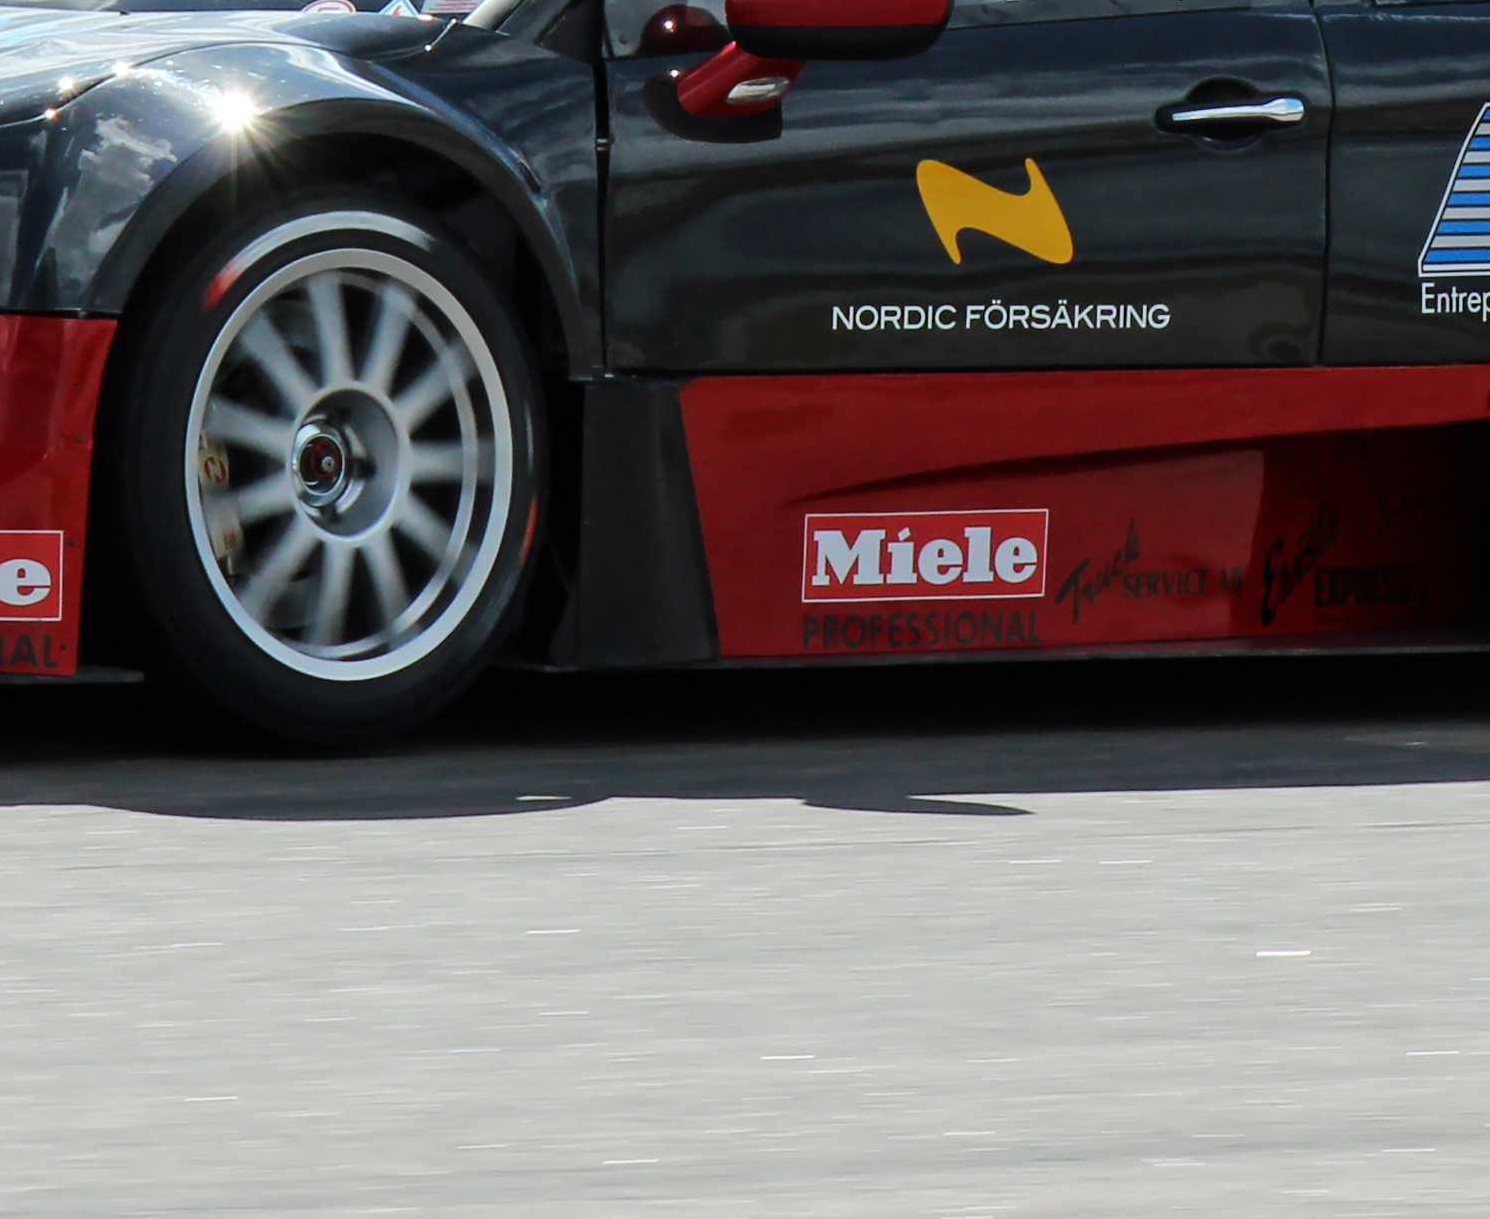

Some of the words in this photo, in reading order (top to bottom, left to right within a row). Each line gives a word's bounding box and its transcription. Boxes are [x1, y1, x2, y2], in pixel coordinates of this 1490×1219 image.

[831, 305, 957, 331] NORDIC
[965, 300, 1172, 330] FÖRSÄKRING
[811, 526, 1038, 587] Miele
[802, 611, 1042, 648] PROFESSIONAL
